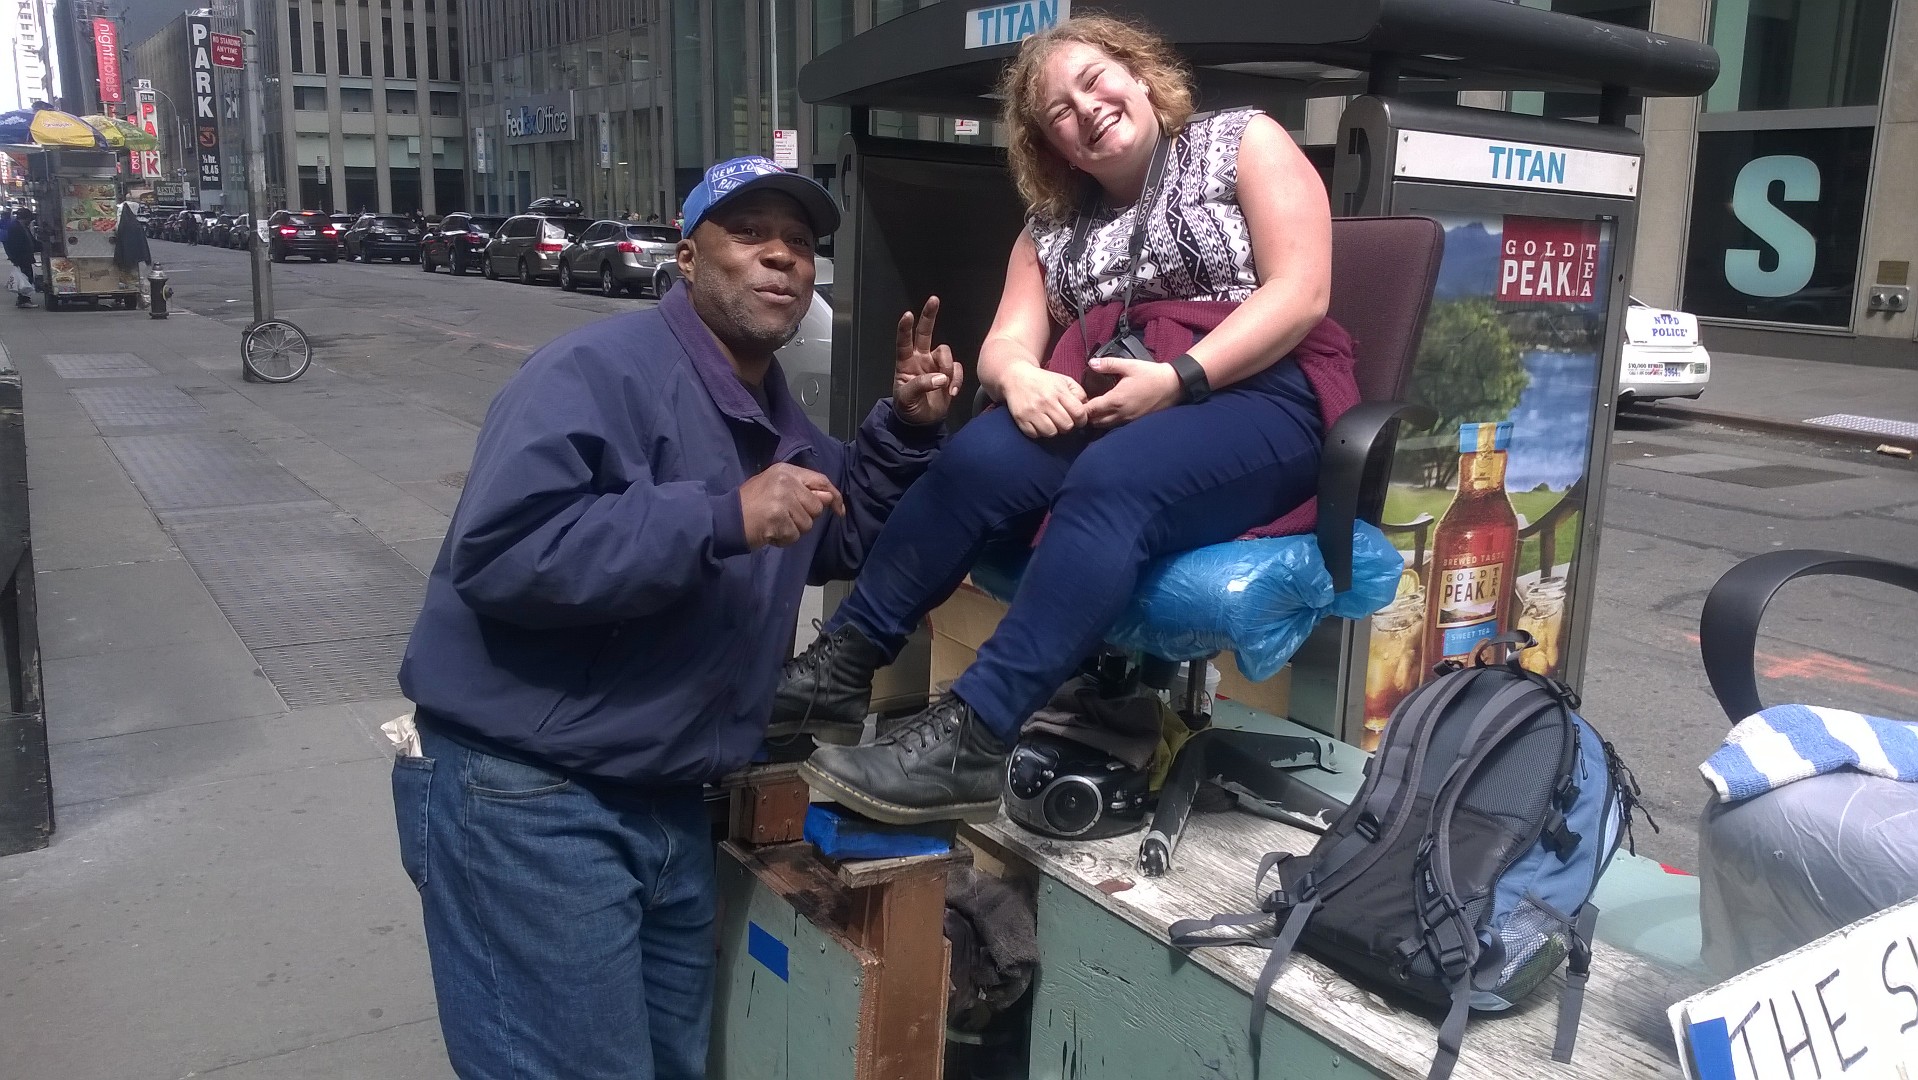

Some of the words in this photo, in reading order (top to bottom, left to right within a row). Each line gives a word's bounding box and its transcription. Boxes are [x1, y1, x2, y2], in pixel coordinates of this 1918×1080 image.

[977, 0, 1058, 46] TITAN
[212, 35, 219, 43] NO
[220, 37, 241, 47] STANDING
[216, 46, 238, 55] ANYTIME
[192, 23, 214, 118] PARK
[711, 165, 737, 181] NEW
[740, 163, 754, 172] YO
[1488, 145, 1566, 184] TITAN
[156, 185, 196, 196] RESTAURNT
[717, 178, 743, 190] RAN
[1724, 154, 1821, 298] S
[1505, 239, 1576, 258] GOLD
[1501, 259, 1573, 297] PEAK
[1580, 243, 1597, 297] TEA
[1653, 315, 1680, 326] NYPD
[1652, 327, 1686, 338] POLICE
[1443, 556, 1477, 567] BREWED
[1480, 551, 1505, 563] TASTE
[1446, 569, 1488, 583] GOLD
[1490, 566, 1500, 597] TEA
[1443, 579, 1485, 604] PEAK
[1451, 630, 1476, 641] SWEET
[1478, 627, 1491, 636] TEA
[1729, 968, 1868, 1080] THE
[1881, 936, 1918, 1035] S
